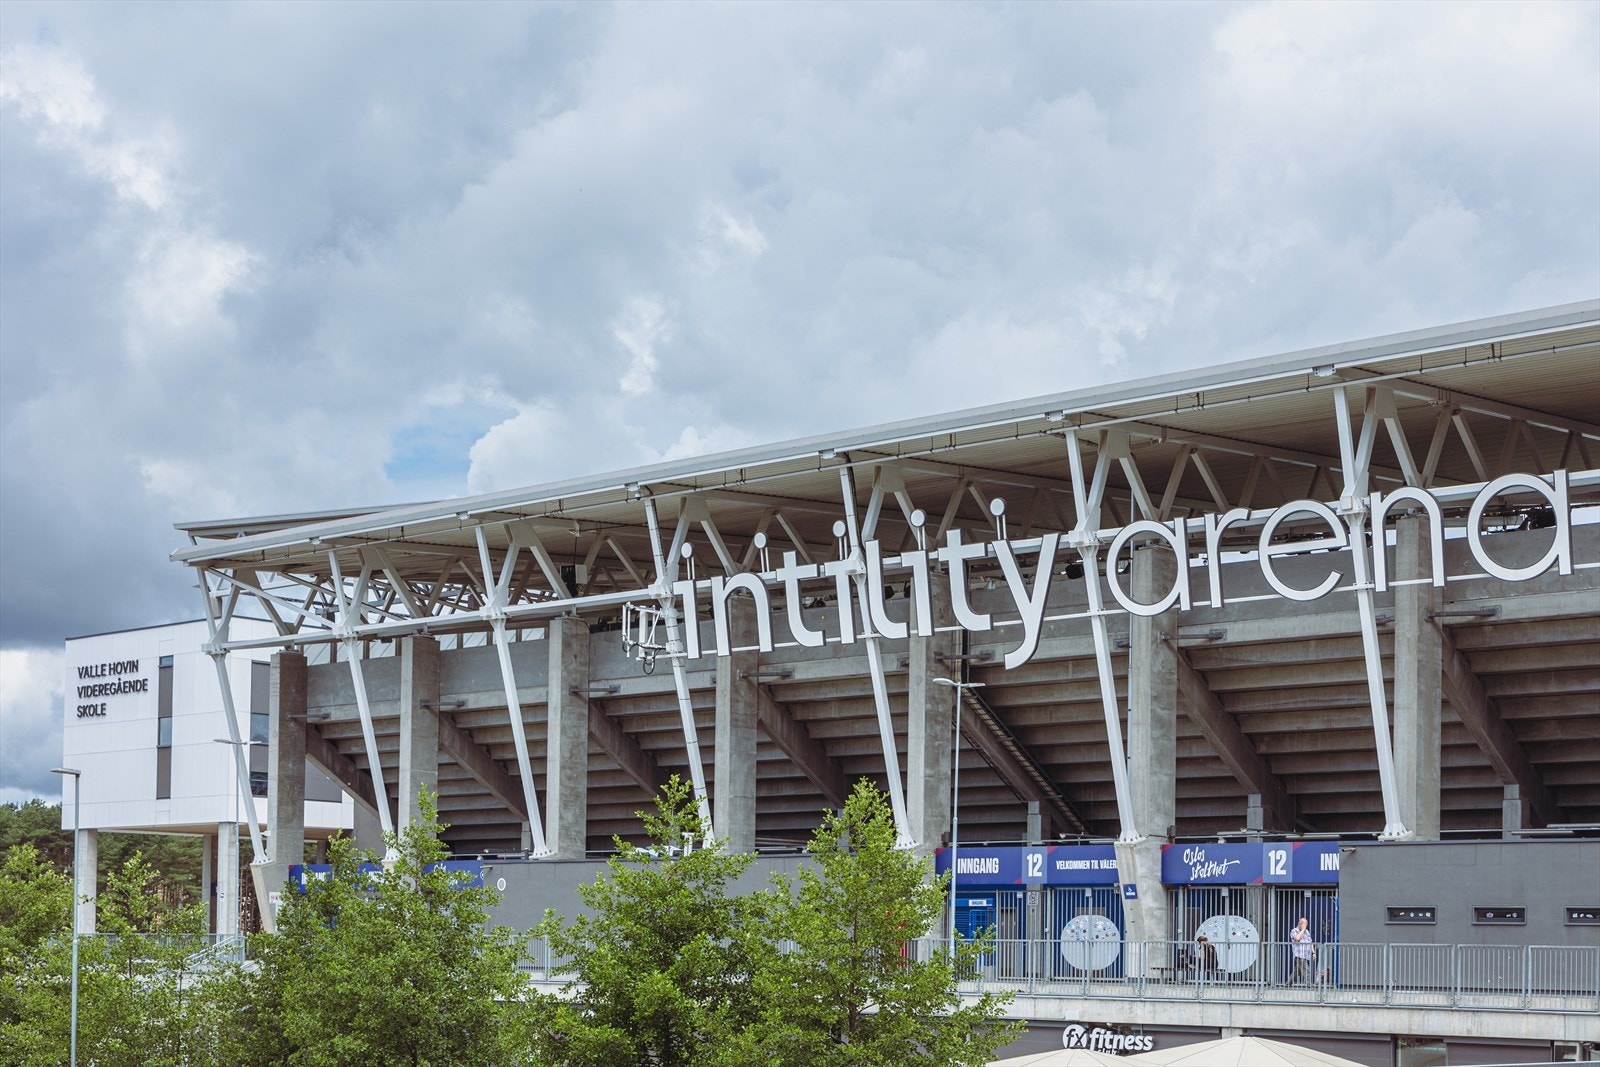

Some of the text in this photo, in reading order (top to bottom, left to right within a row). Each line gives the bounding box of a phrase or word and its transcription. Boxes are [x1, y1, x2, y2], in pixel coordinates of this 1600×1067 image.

[672, 468, 1575, 670] intility arena
[78, 660, 138, 678] VALLE HOVIN
[77, 678, 148, 698] VIDEREGÅENDE
[77, 703, 106, 718] SKOLE
[1026, 853, 1043, 877] 12
[1056, 860, 1090, 870] VELKOMMEN
[1091, 860, 1100, 870] TIL
[1183, 846, 1205, 865] Oslos
[1268, 850, 1287, 876] 12
[1320, 853, 1340, 871] INN
[958, 858, 999, 874] INNGANG
[1065, 1027, 1154, 1052] fx fitness
